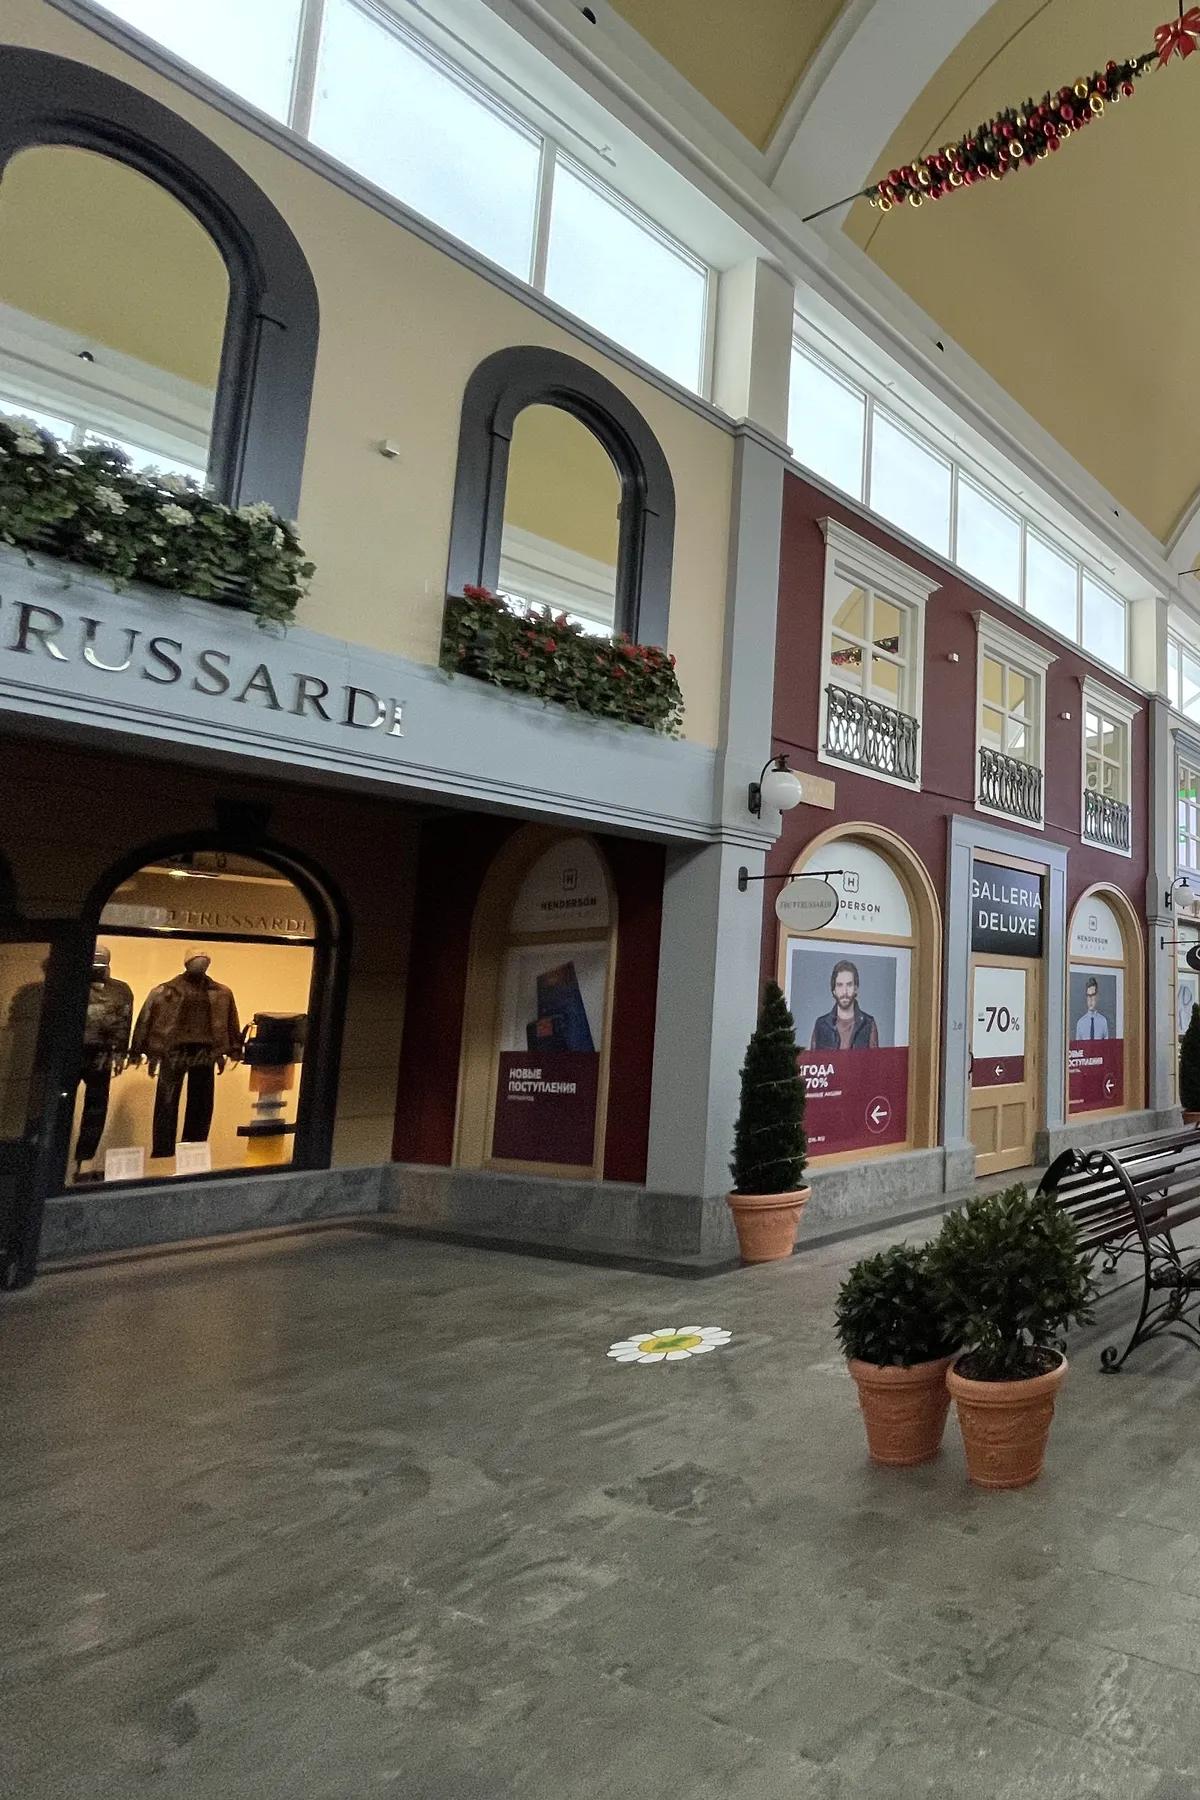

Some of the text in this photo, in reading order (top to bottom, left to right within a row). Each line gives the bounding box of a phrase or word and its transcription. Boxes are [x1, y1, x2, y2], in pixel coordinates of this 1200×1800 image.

[0, 597, 406, 738] RUSSARDI
[971, 879, 1043, 910] GALLERIA
[541, 897, 597, 911] HENDERSON
[840, 900, 880, 913] DERSON
[186, 911, 308, 933] TRUSSARDI
[978, 910, 1036, 936] DELUXE
[977, 1006, 1020, 1032] -70%
[509, 1068, 542, 1079] НОВЫЕ
[799, 1064, 834, 1077] ГОДА
[508, 1081, 577, 1094] ПОСТУПЛЕНИЯ
[805, 1077, 829, 1088] 70%
